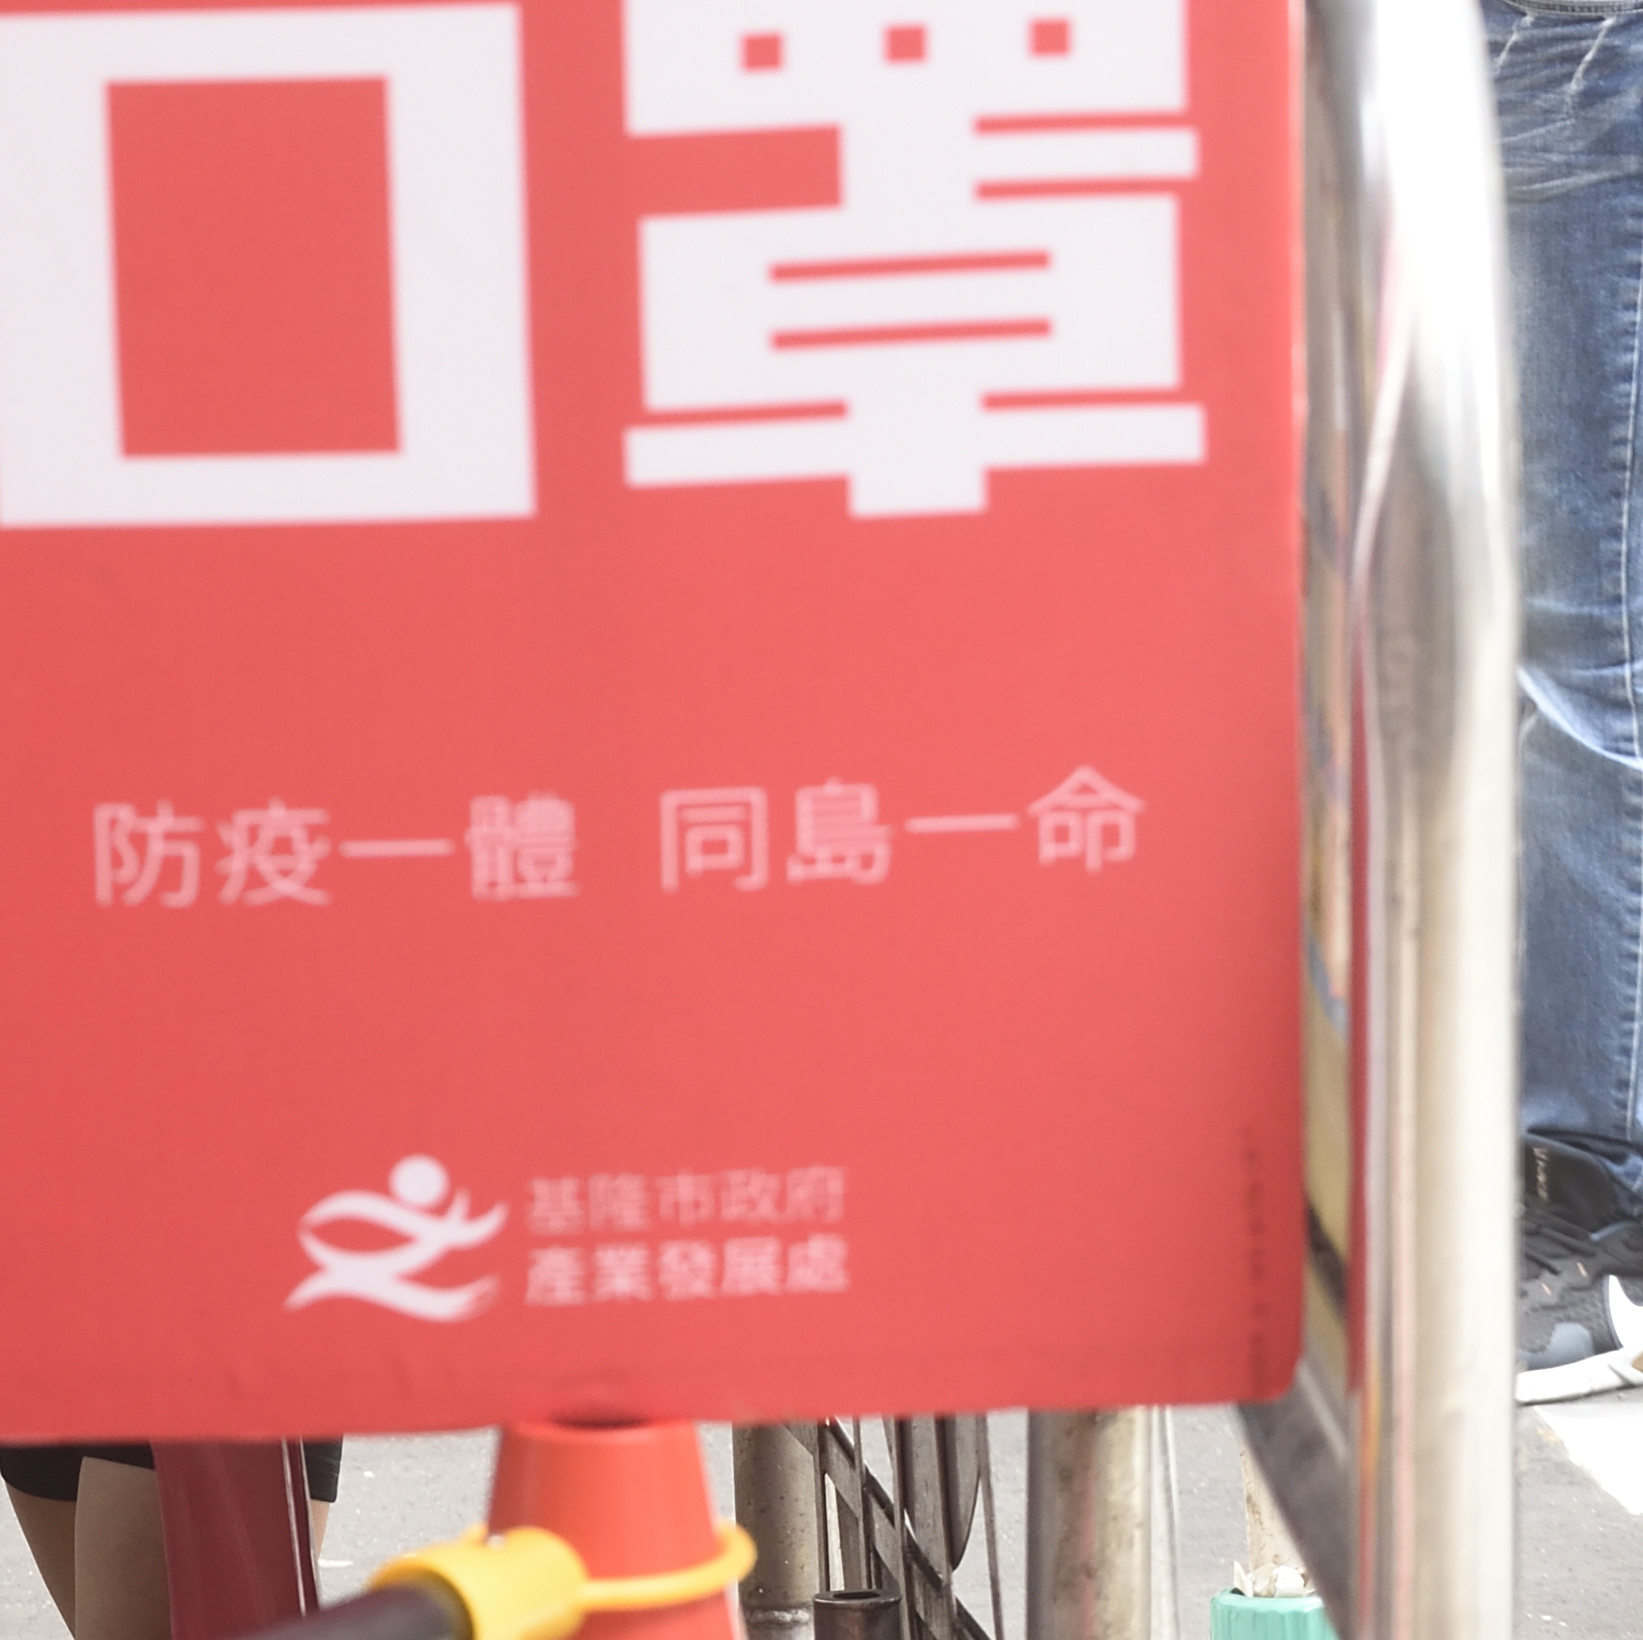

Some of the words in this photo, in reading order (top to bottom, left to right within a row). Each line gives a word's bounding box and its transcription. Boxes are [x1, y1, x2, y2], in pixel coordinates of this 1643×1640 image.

[91, 791, 580, 908] 防疫一體
[658, 765, 1145, 893] 同島一命
[524, 1163, 846, 1236] 基隆市政府
[523, 1232, 850, 1306] 產業發展處
